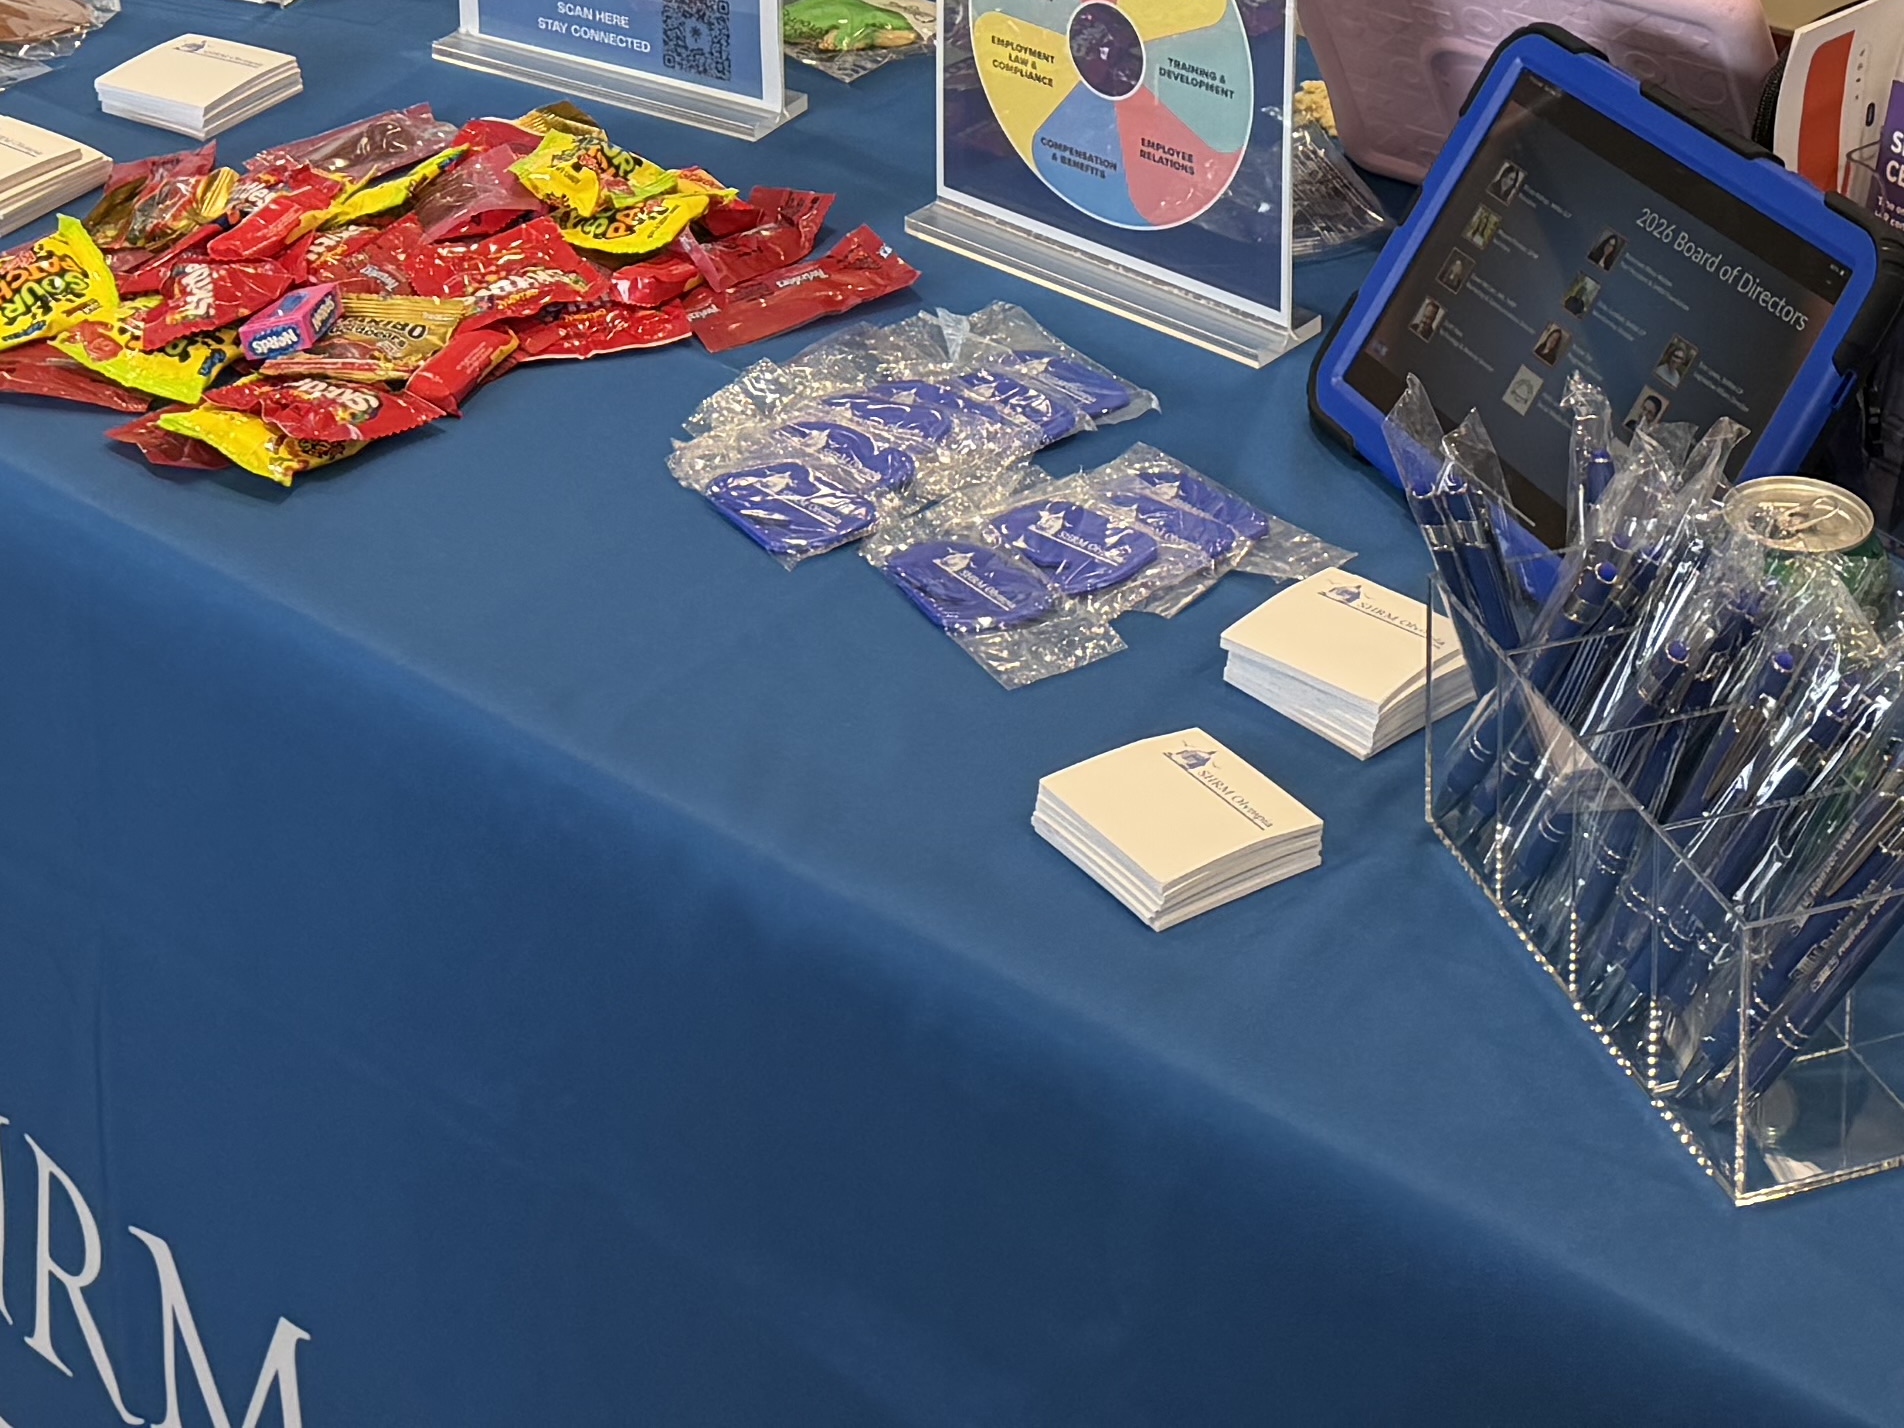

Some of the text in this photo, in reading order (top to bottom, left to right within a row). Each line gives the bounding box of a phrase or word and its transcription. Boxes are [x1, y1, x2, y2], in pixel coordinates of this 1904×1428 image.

[557, 2, 629, 28] SCAN HERE
[537, 17, 651, 53] STAY CONNECTED
[991, 36, 1055, 64] EMPLOYMENT
[992, 59, 1053, 87] COMPLIANCE
[1159, 67, 1234, 99] DEVELOPMENT
[1168, 57, 1217, 82] TRAINING
[1040, 136, 1117, 171] COMPENSATION
[1140, 149, 1195, 176] RELATIONS
[1141, 138, 1193, 163] EMPLOYEE
[1636, 207, 1677, 244] 2026
[1673, 233, 1727, 275] Board
[1719, 264, 1740, 284] of
[1736, 269, 1809, 332] Directors
[1356, 598, 1399, 625] SHRM
[1195, 768, 1237, 801] SHRM
